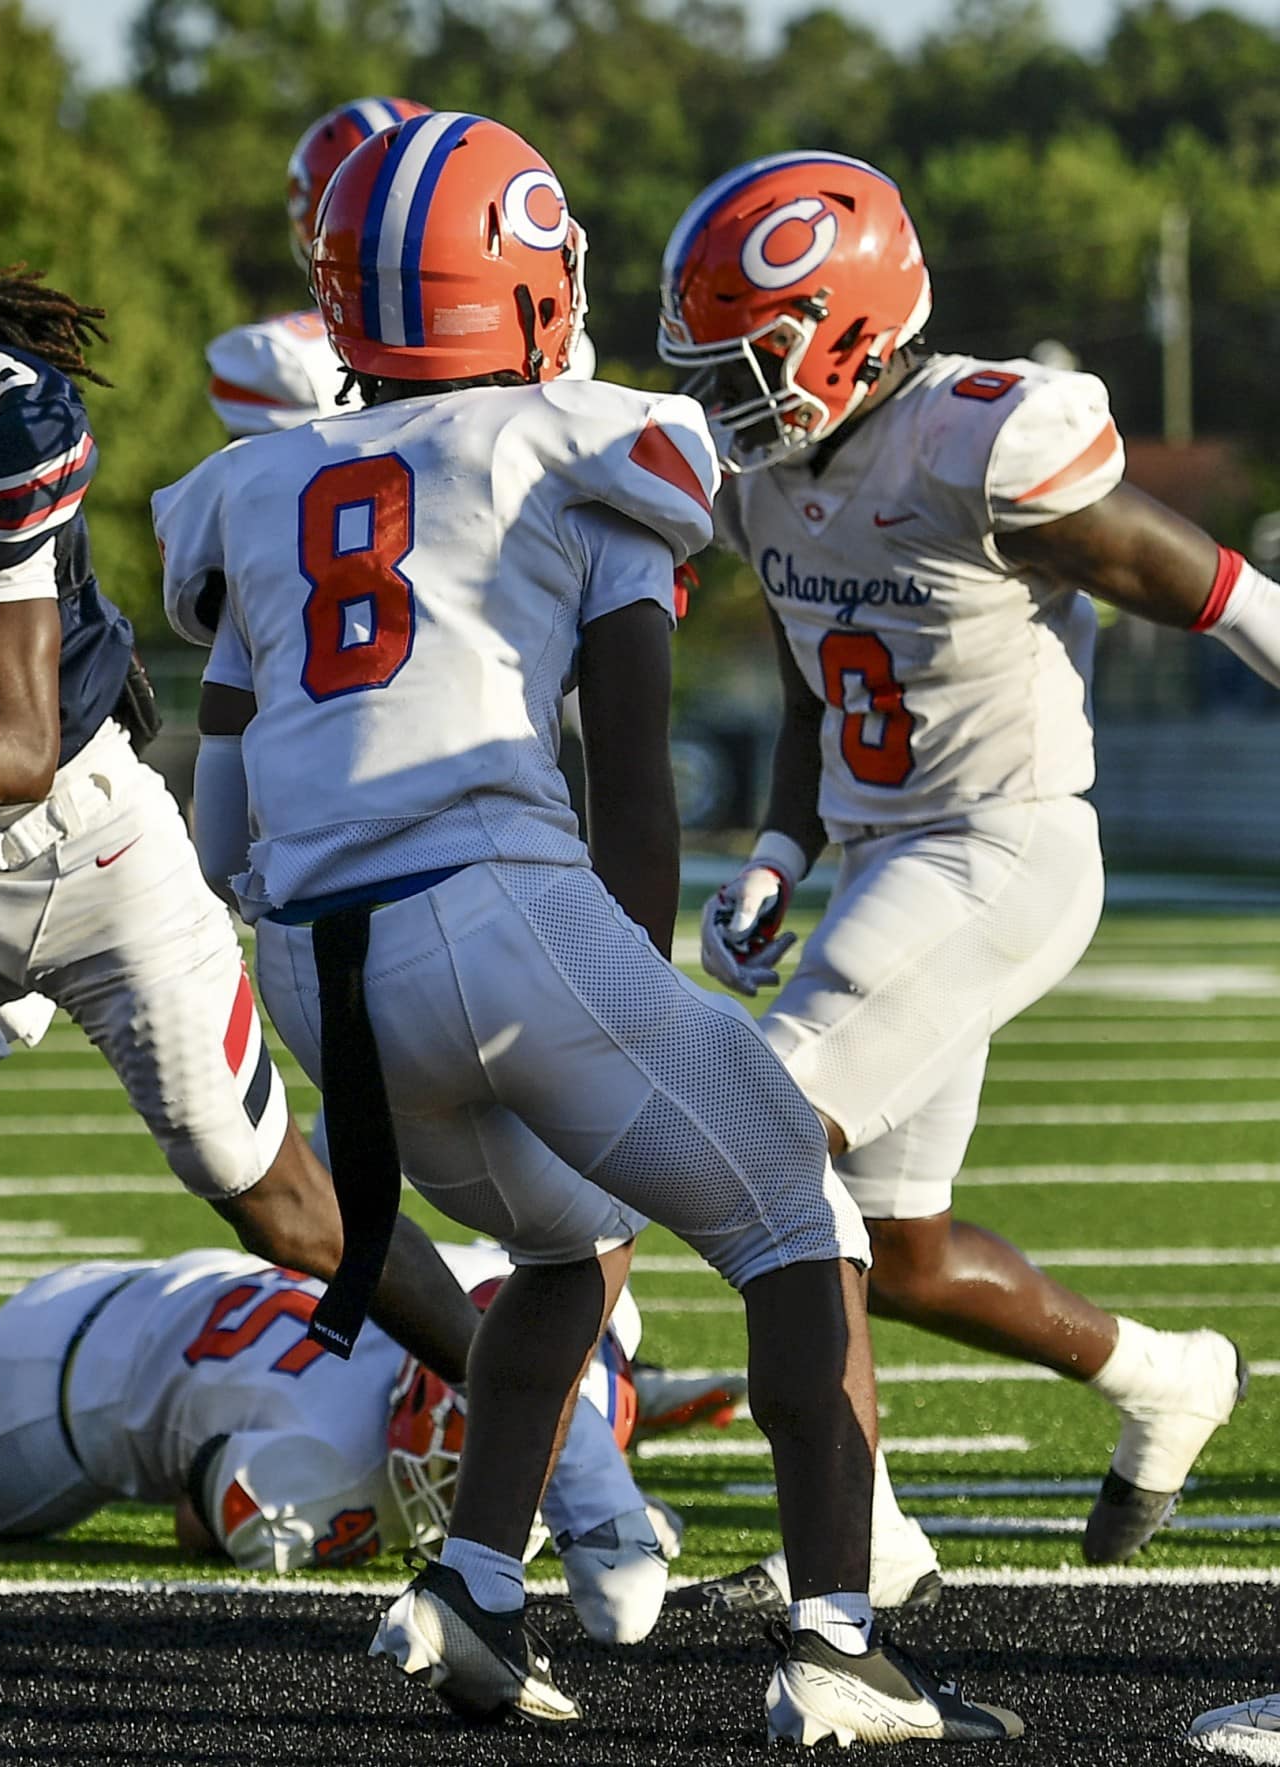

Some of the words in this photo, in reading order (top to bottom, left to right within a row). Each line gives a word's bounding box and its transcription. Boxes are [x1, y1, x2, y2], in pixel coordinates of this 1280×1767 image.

[501, 168, 571, 252] C
[739, 196, 840, 290] C
[951, 369, 1027, 403] 0
[297, 450, 416, 705] 8
[760, 546, 934, 624] Chargers
[819, 630, 917, 789] 0
